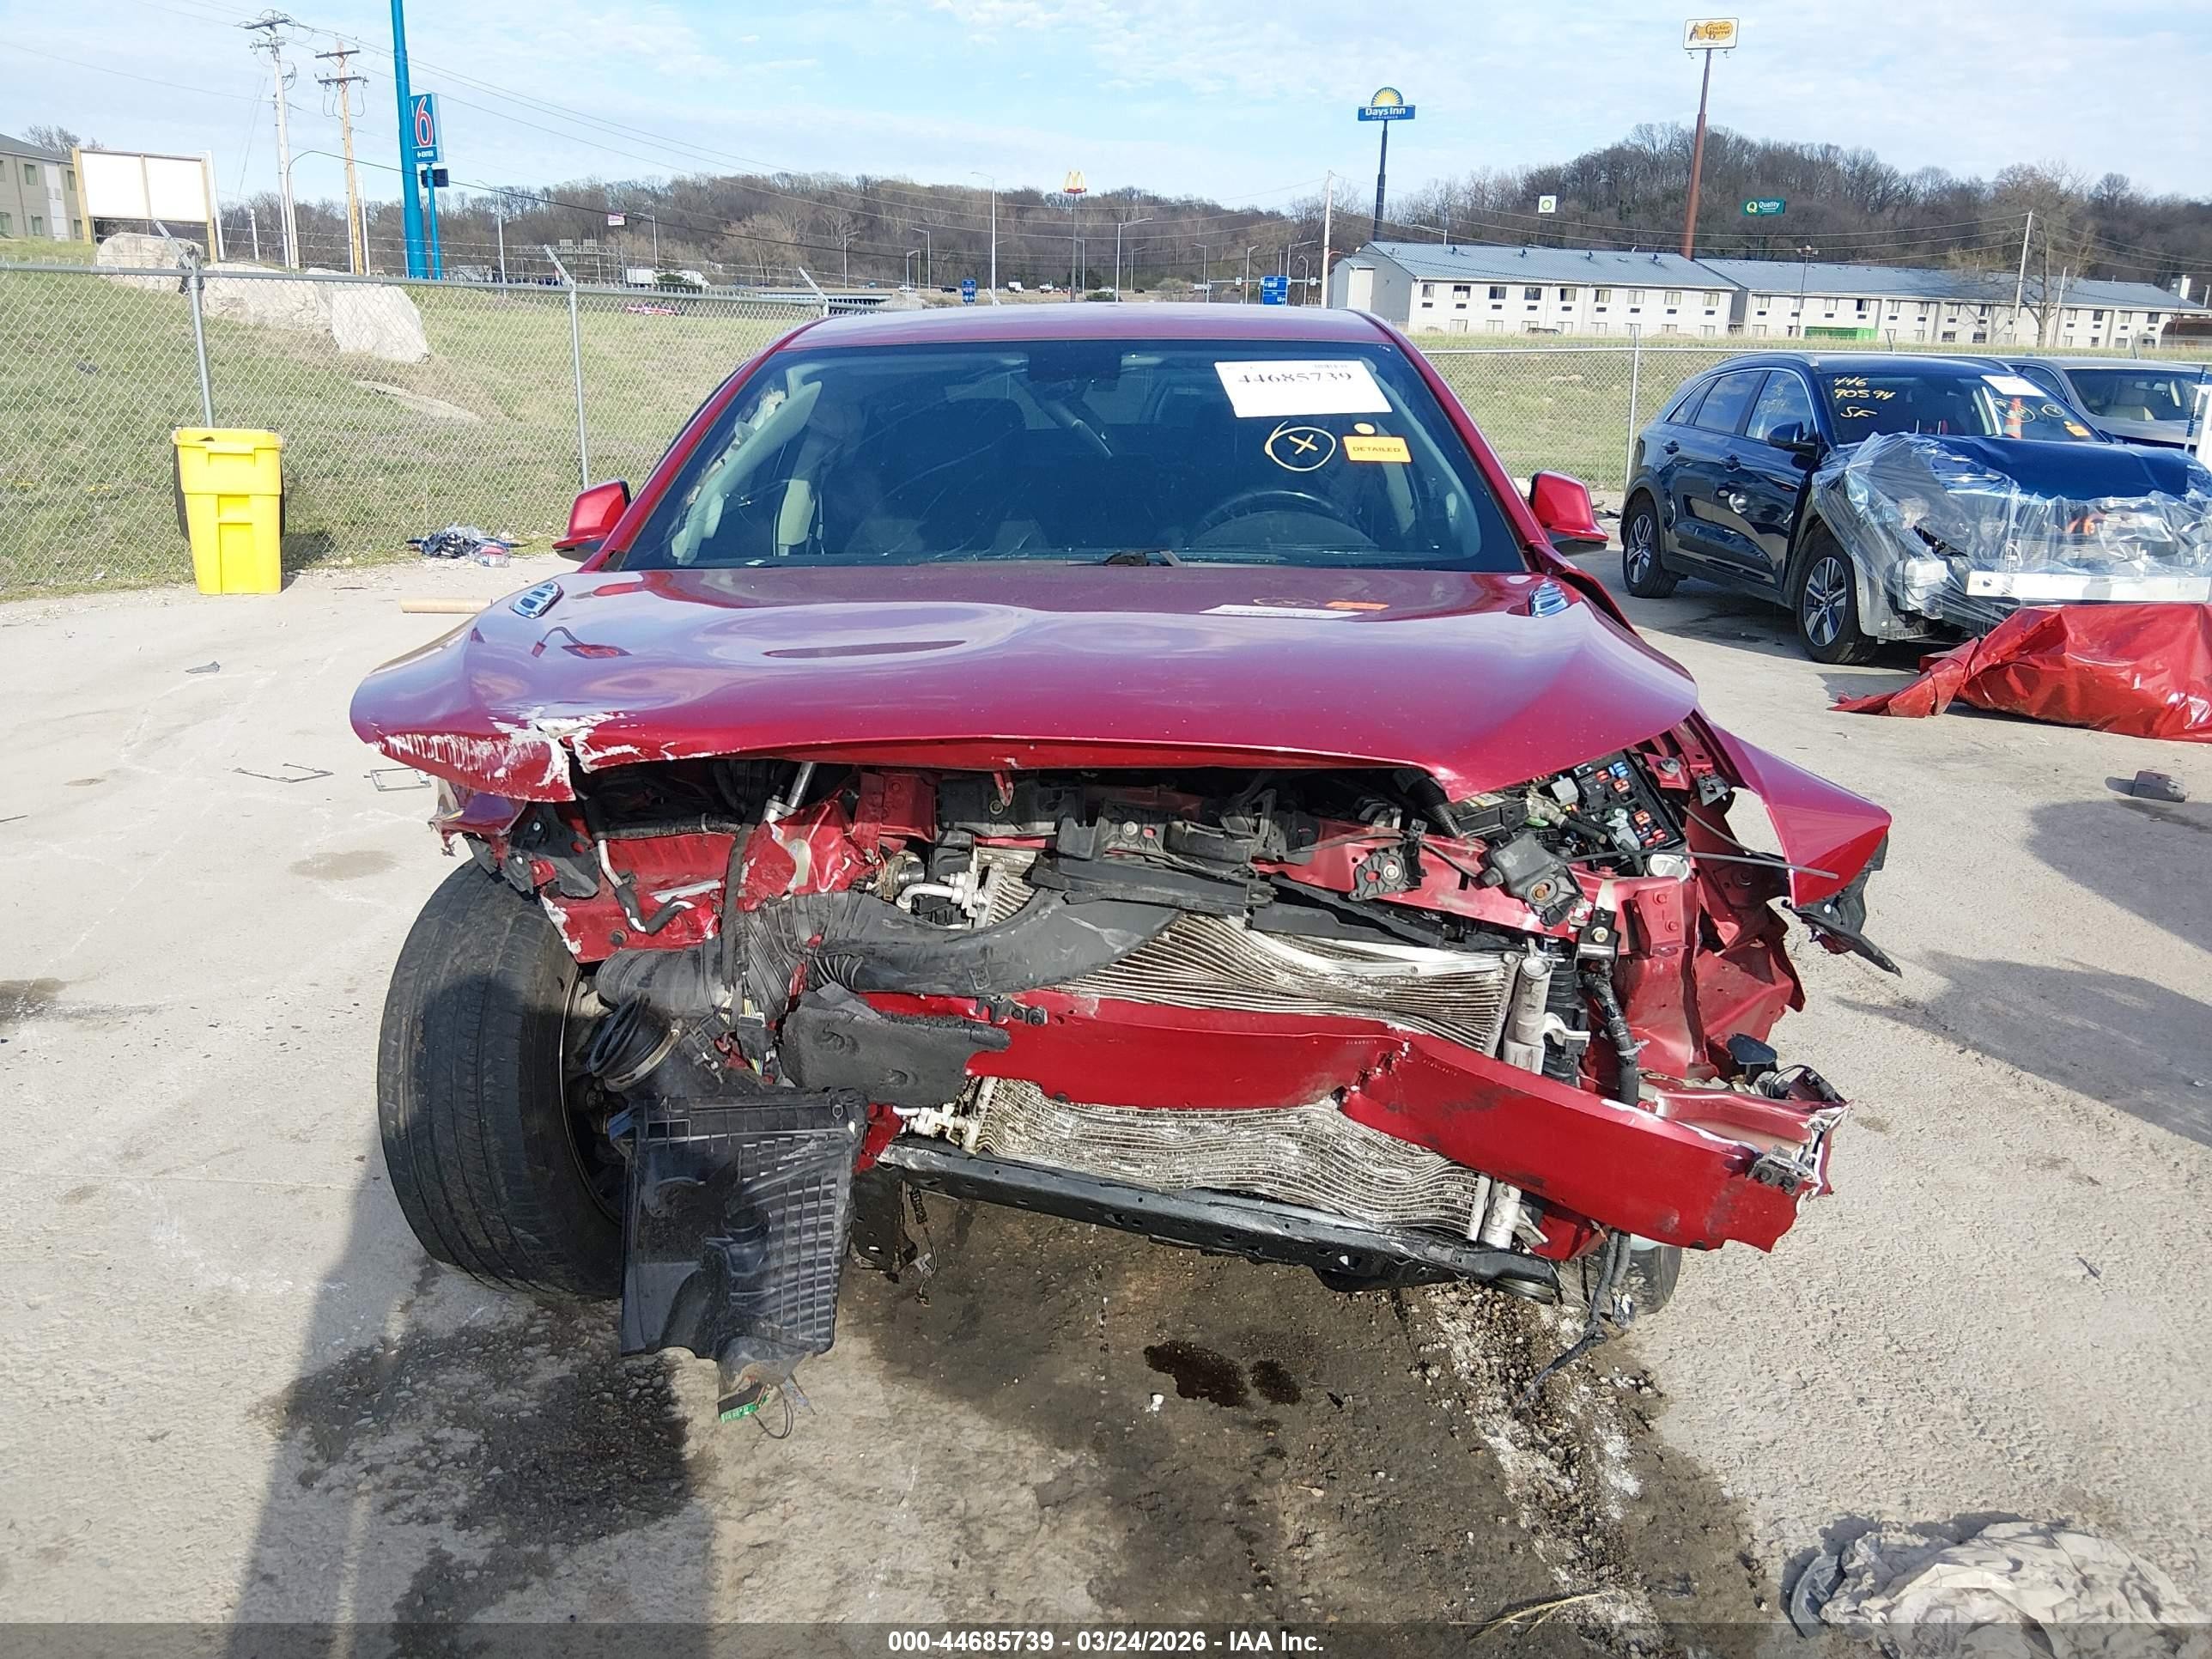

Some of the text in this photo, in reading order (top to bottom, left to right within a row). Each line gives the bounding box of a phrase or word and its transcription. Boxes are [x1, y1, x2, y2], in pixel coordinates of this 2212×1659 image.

[1365, 106, 1406, 117] Days Inn
[415, 95, 434, 147] 6
[1759, 201, 1780, 210] Quality
[1238, 371, 1352, 385] 44685739
[1833, 376, 1869, 386] 446
